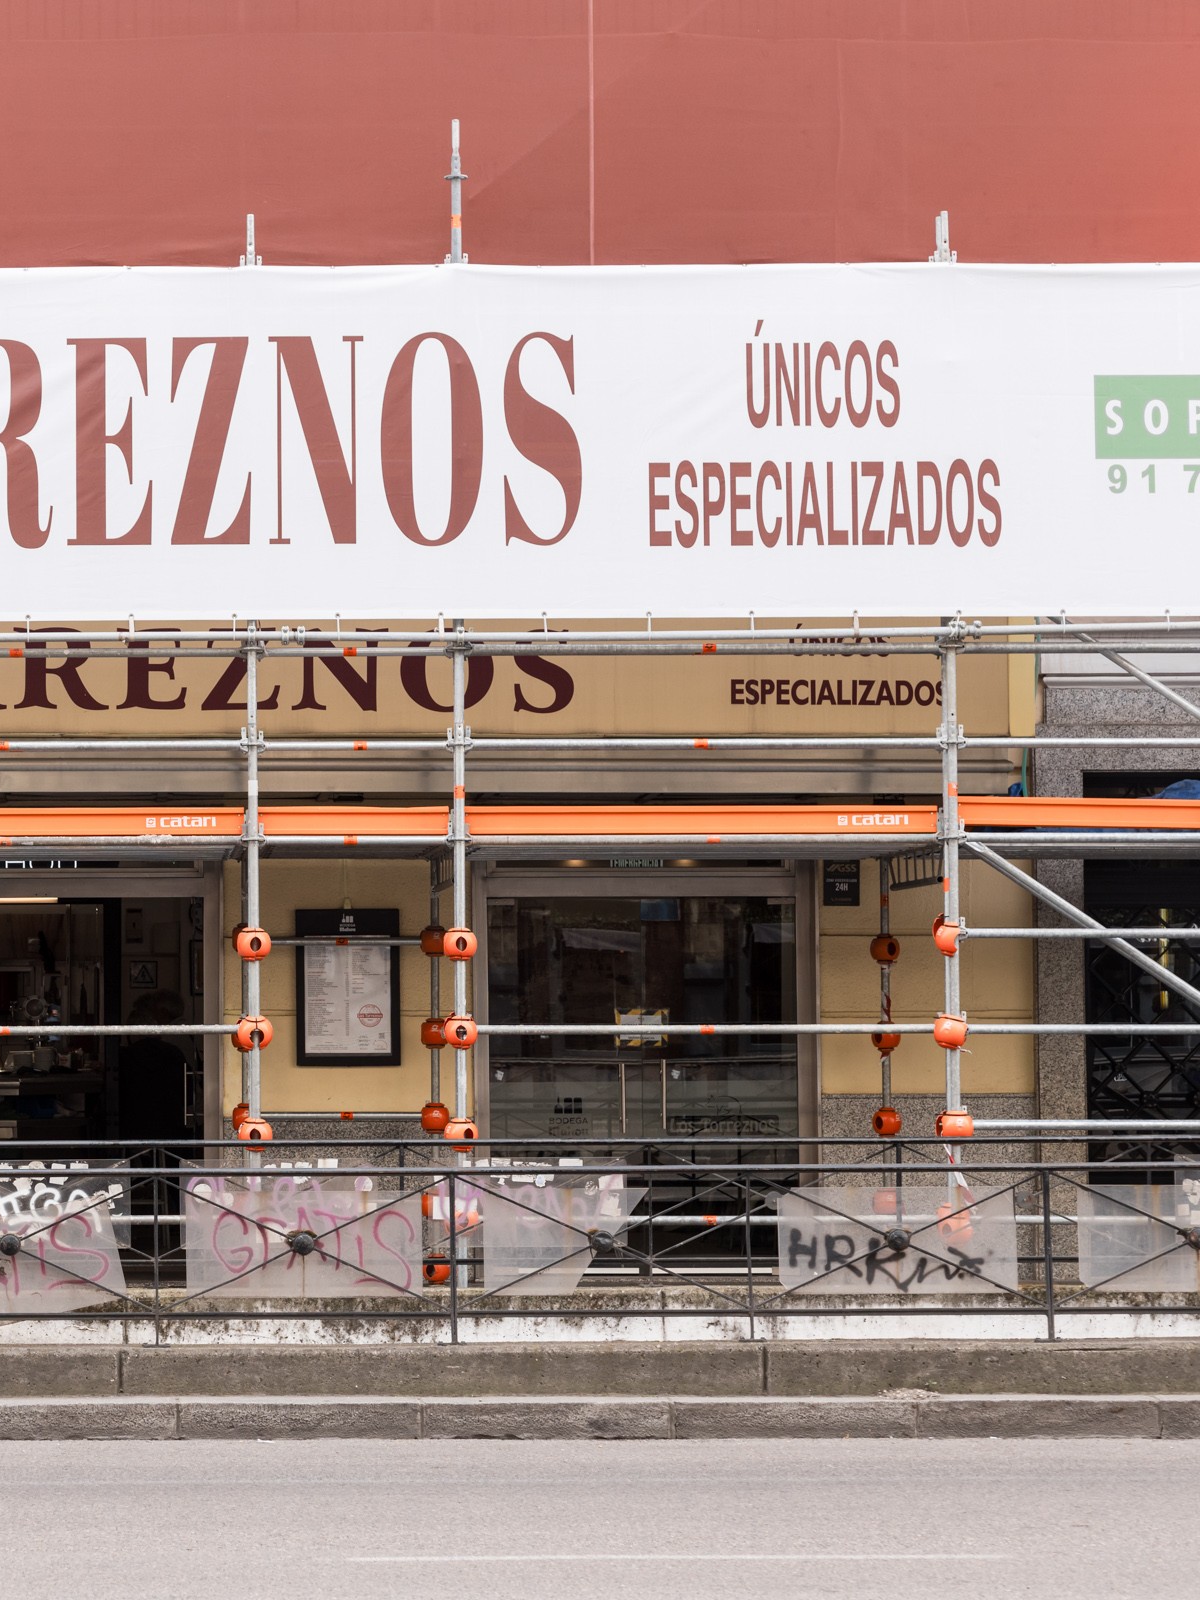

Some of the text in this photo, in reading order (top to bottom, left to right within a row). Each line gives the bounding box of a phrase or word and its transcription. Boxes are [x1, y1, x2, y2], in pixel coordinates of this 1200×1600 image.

[747, 320, 899, 428] ÚNICOS
[649, 460, 1001, 548] ESPECIALIZADOS
[731, 679, 943, 706] ESPECIALIZADOS
[160, 816, 216, 828] catari
[852, 814, 909, 826] catari
[835, 883, 848, 891] 24H
